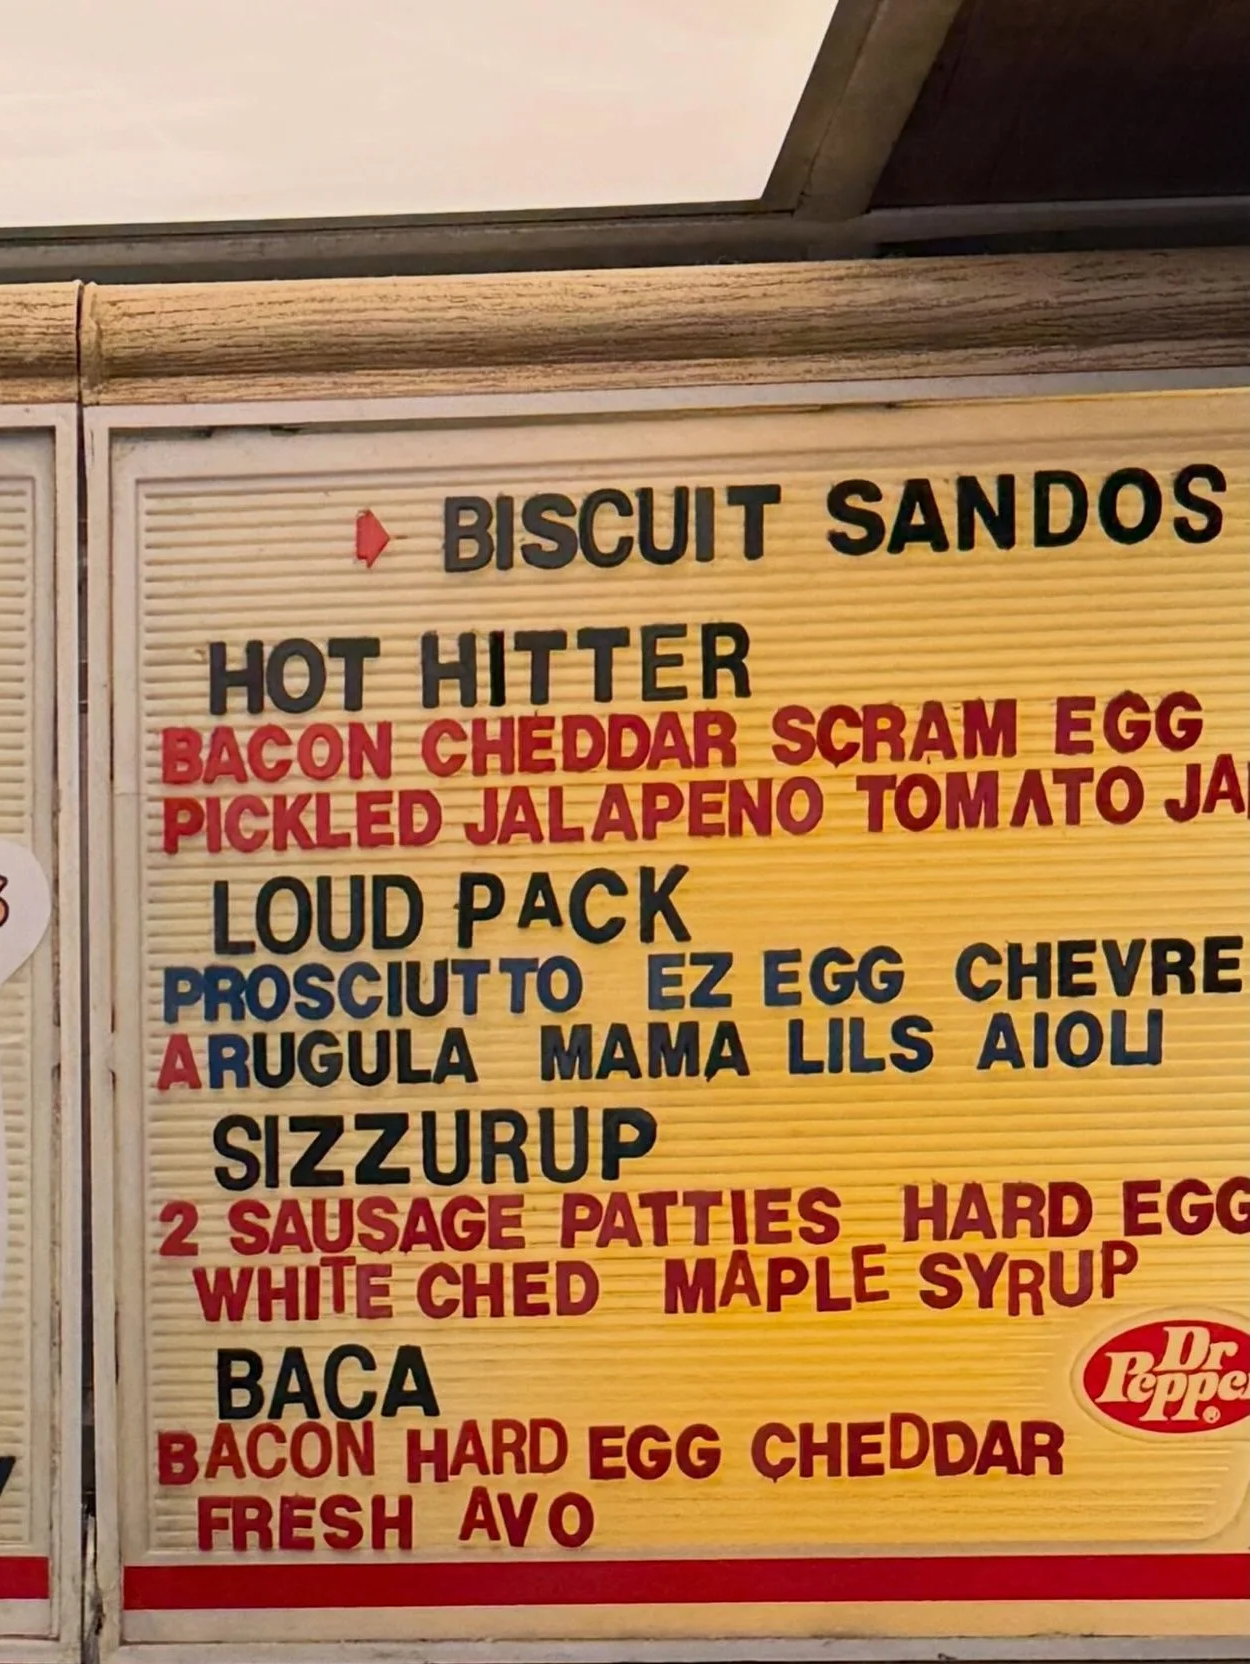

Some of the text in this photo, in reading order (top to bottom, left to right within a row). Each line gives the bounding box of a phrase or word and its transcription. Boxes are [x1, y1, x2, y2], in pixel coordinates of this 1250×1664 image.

[443, 463, 1228, 573] BISCUIT SANDOS
[207, 621, 752, 716] HOT HITTER
[160, 690, 1203, 786] BACON CHEDDAR SCRAM EGG
[161, 753, 1250, 856] PICKLED JALAPENO TOMATO JA
[213, 863, 693, 956] LOUD PACK
[162, 934, 1245, 1024] PROSCIUTTO EZ EGG CHEVRE
[156, 1009, 1164, 1092] ARUGULA MAMA LILS AIOLI
[211, 1106, 659, 1193] SIZZURUP
[158, 1176, 1250, 1258] 2 SAUSAGE PATTIES HARD EGG
[193, 1239, 1140, 1323] WHITE CHED MAPLE SYRUP
[216, 1343, 440, 1422] BACA
[1095, 1350, 1250, 1421] Peppe
[1153, 1326, 1238, 1371] Dr
[156, 1410, 1064, 1488] BACON HARD EGG CHEDDAR
[196, 1486, 595, 1553] FRESH AVO
